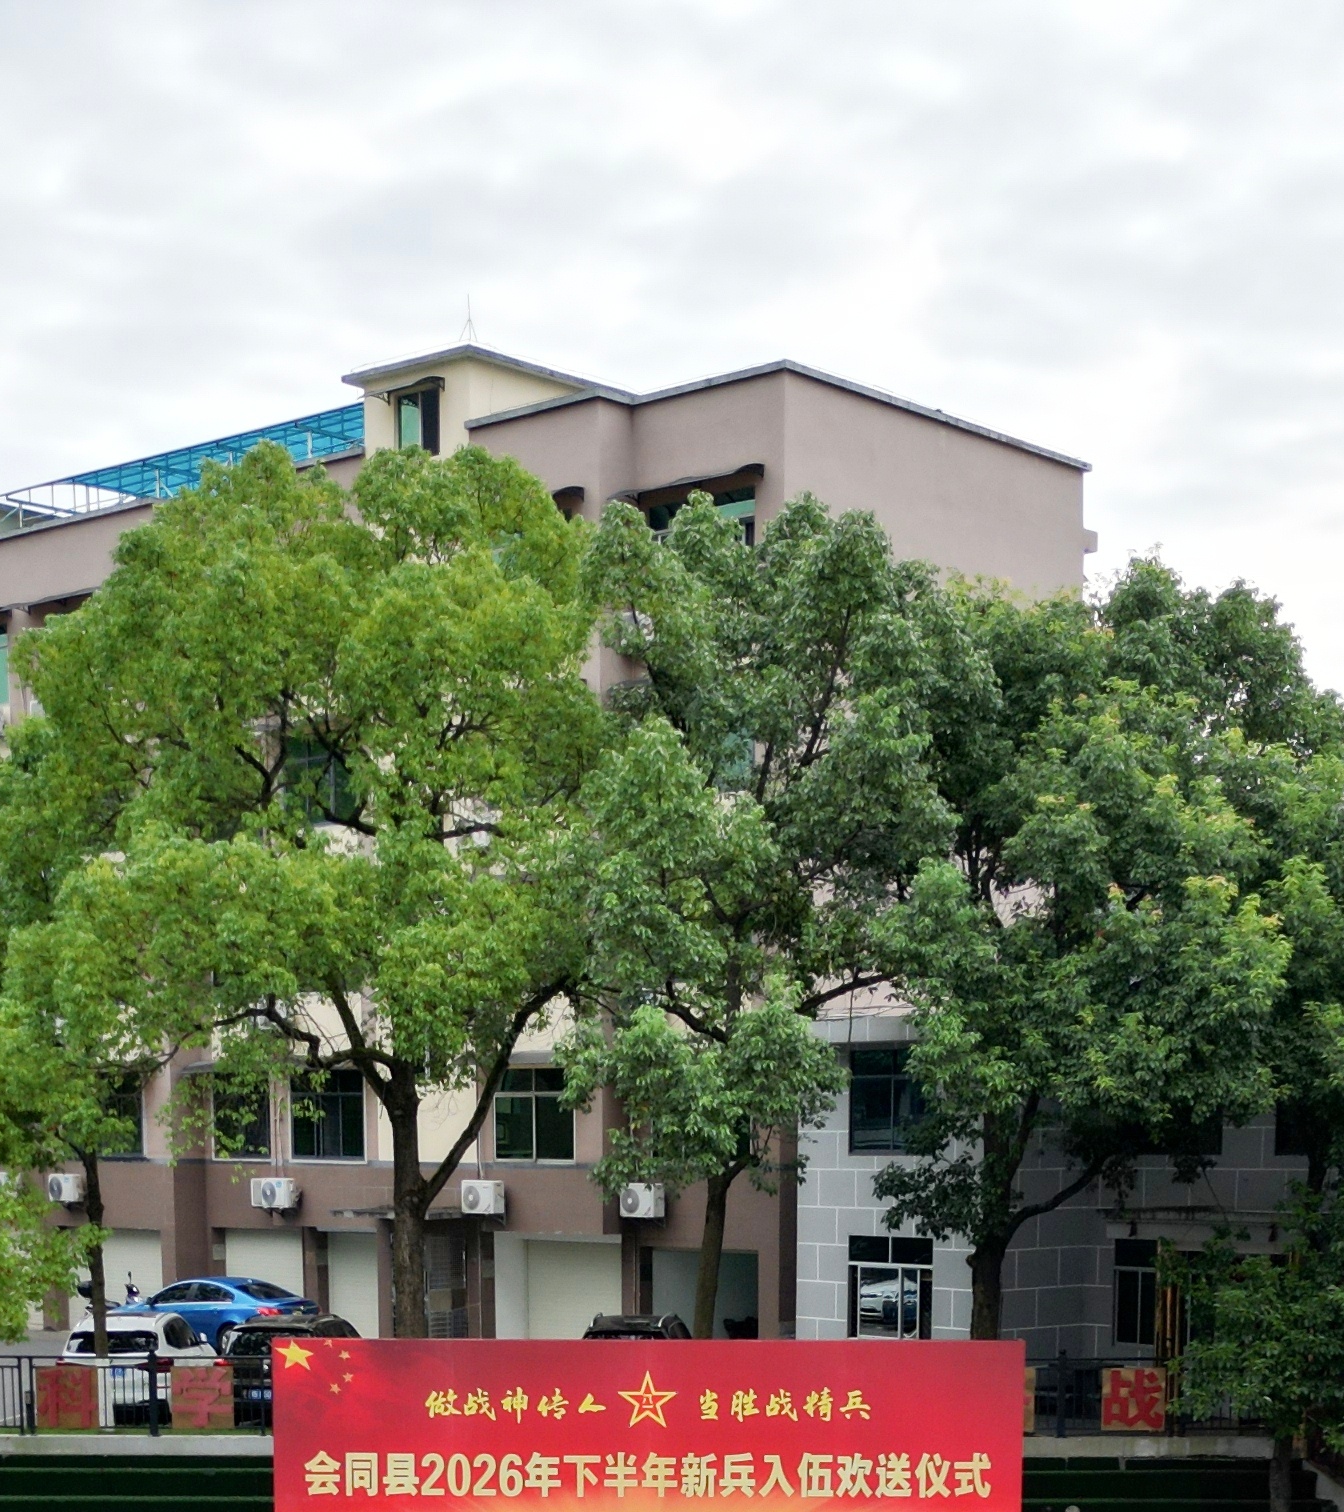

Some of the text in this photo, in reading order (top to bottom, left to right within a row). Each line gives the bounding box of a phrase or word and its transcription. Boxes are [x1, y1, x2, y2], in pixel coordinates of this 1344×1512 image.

[37, 1366, 98, 1429] 科
[171, 1365, 234, 1428] 学
[425, 1386, 872, 1425] 做战神传人 当胜战精兵
[1102, 1368, 1164, 1429] 战
[304, 1450, 992, 1498] 会同县2026年下半年新兵入伍欢送仪式
